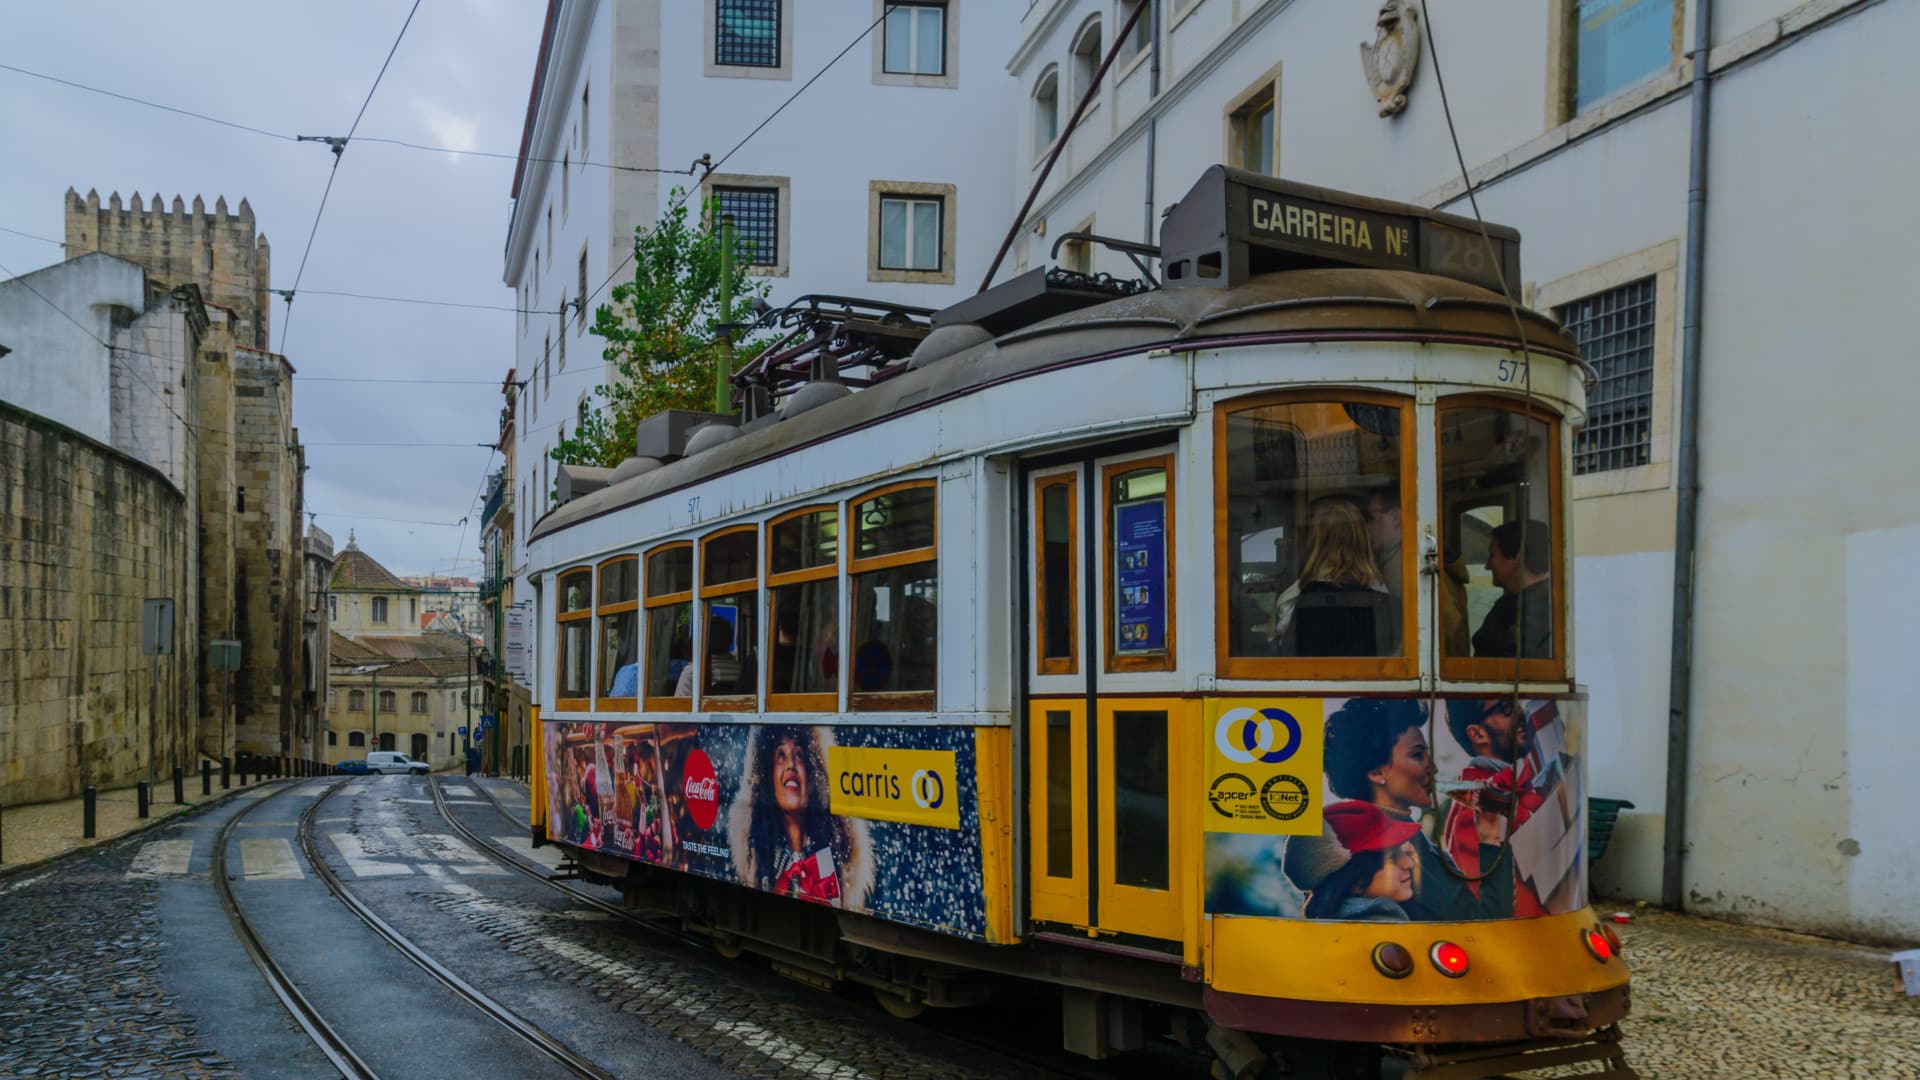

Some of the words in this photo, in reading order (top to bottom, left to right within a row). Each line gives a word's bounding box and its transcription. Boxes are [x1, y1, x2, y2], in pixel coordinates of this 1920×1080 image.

[1253, 198, 1373, 251] CARREIRA
[1440, 233, 1484, 272] 28
[1498, 360, 1529, 385] 577
[689, 496, 700, 513] 577
[685, 776, 715, 800] Coca-Cola
[840, 763, 901, 801] carris
[1217, 791, 1249, 803] apcer
[682, 840, 697, 853] TASTE
[697, 843, 707, 855] THE
[707, 845, 729, 858] FEELING
